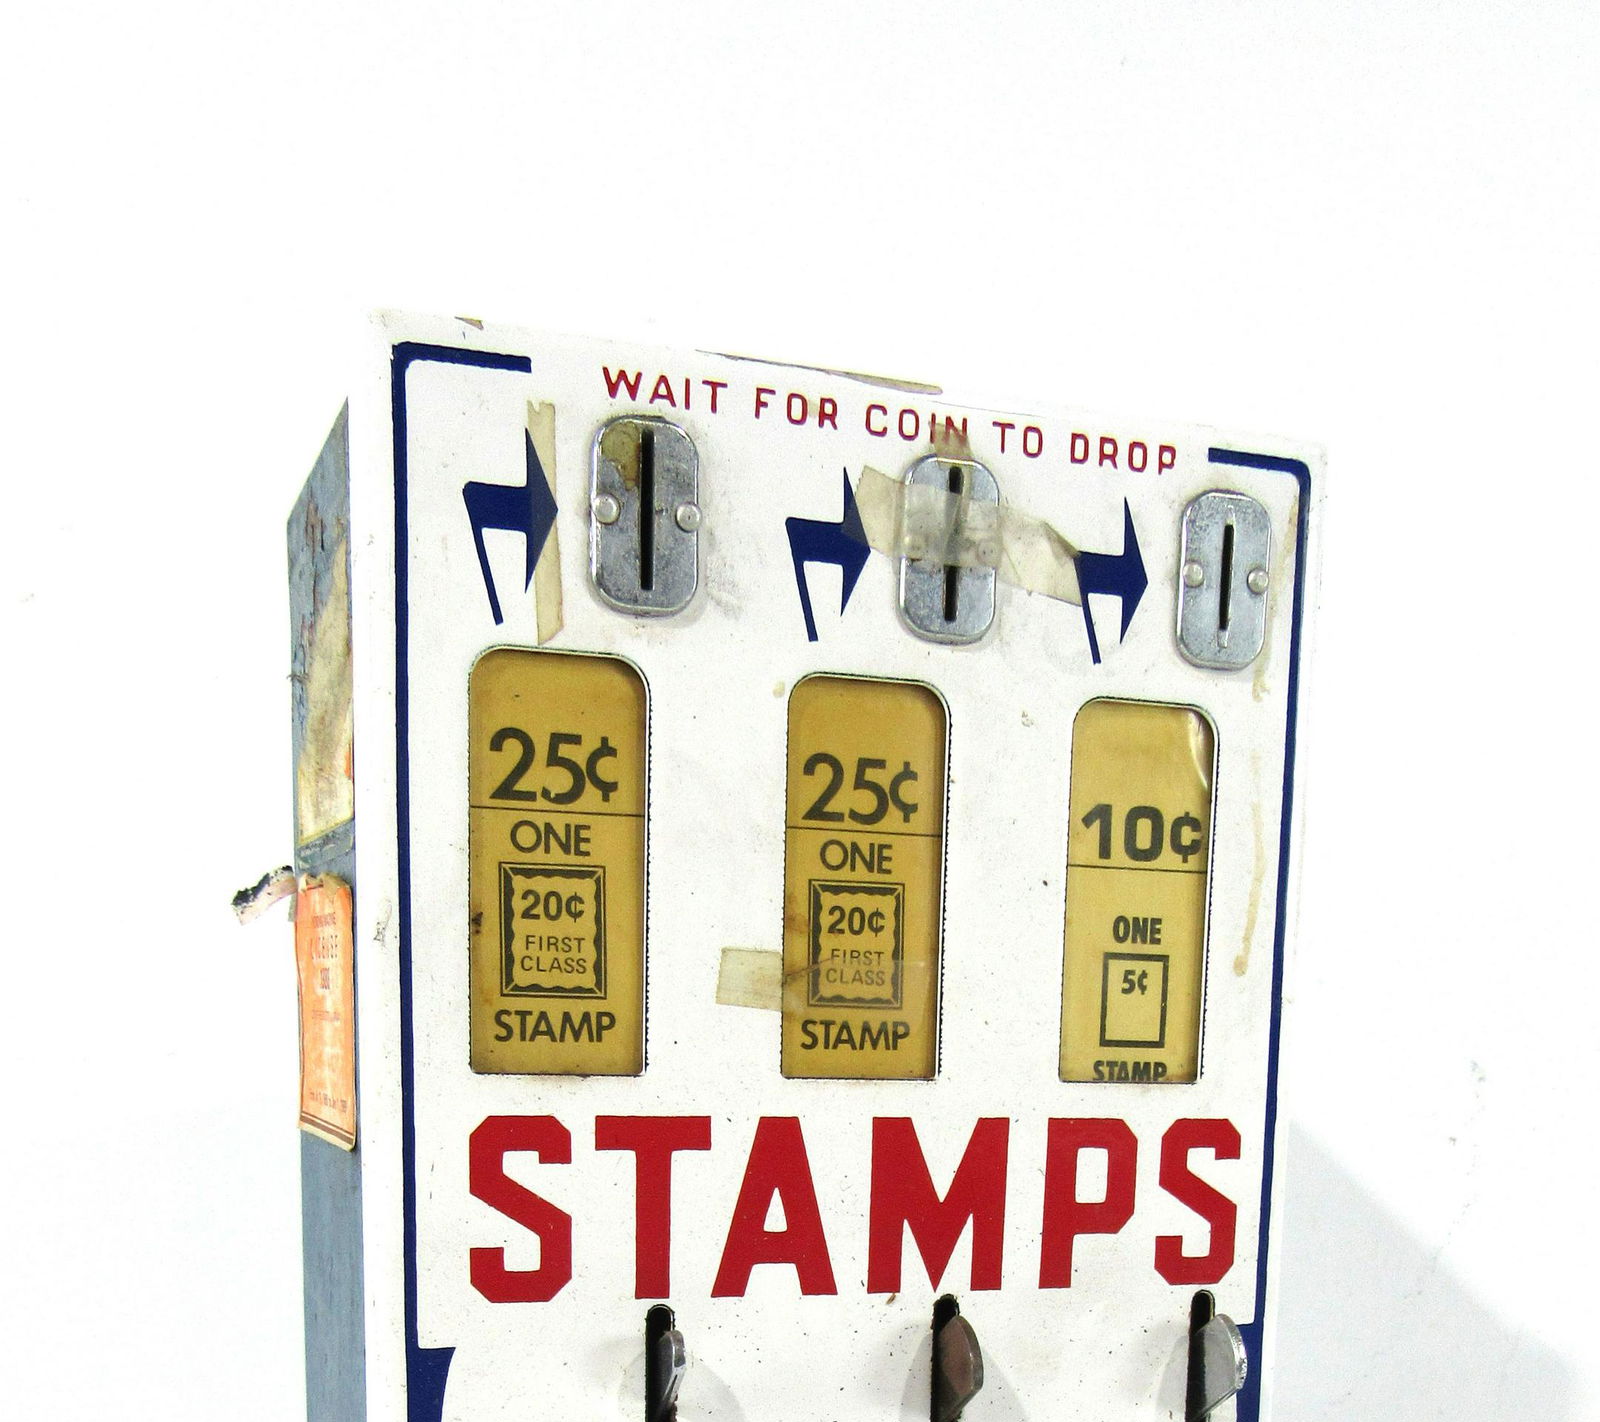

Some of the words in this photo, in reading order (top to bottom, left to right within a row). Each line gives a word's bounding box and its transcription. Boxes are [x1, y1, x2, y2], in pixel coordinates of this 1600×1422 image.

[602, 366, 727, 414] WAIT
[754, 387, 838, 430] FOR
[865, 404, 968, 447] COIN
[993, 421, 1044, 456] TO
[1070, 432, 1177, 475] DROP
[489, 727, 618, 805] 25¢
[802, 753, 918, 826] 25¢
[510, 820, 591, 857] ONE
[1081, 803, 1201, 863] 10¢
[820, 840, 893, 874] ONE
[521, 889, 585, 923] 20¢
[828, 905, 885, 937] 20¢
[525, 935, 585, 954] FIRST
[1113, 916, 1162, 945] ONE
[520, 955, 587, 974] CLASS
[830, 949, 884, 967] FIRST
[825, 967, 886, 988] CLASS
[1121, 970, 1148, 995] 5¢
[494, 1009, 616, 1043] STAMP
[800, 1020, 910, 1052] STAMP
[1093, 1060, 1167, 1081] STAMP
[469, 1115, 1242, 1304] STAMPS
